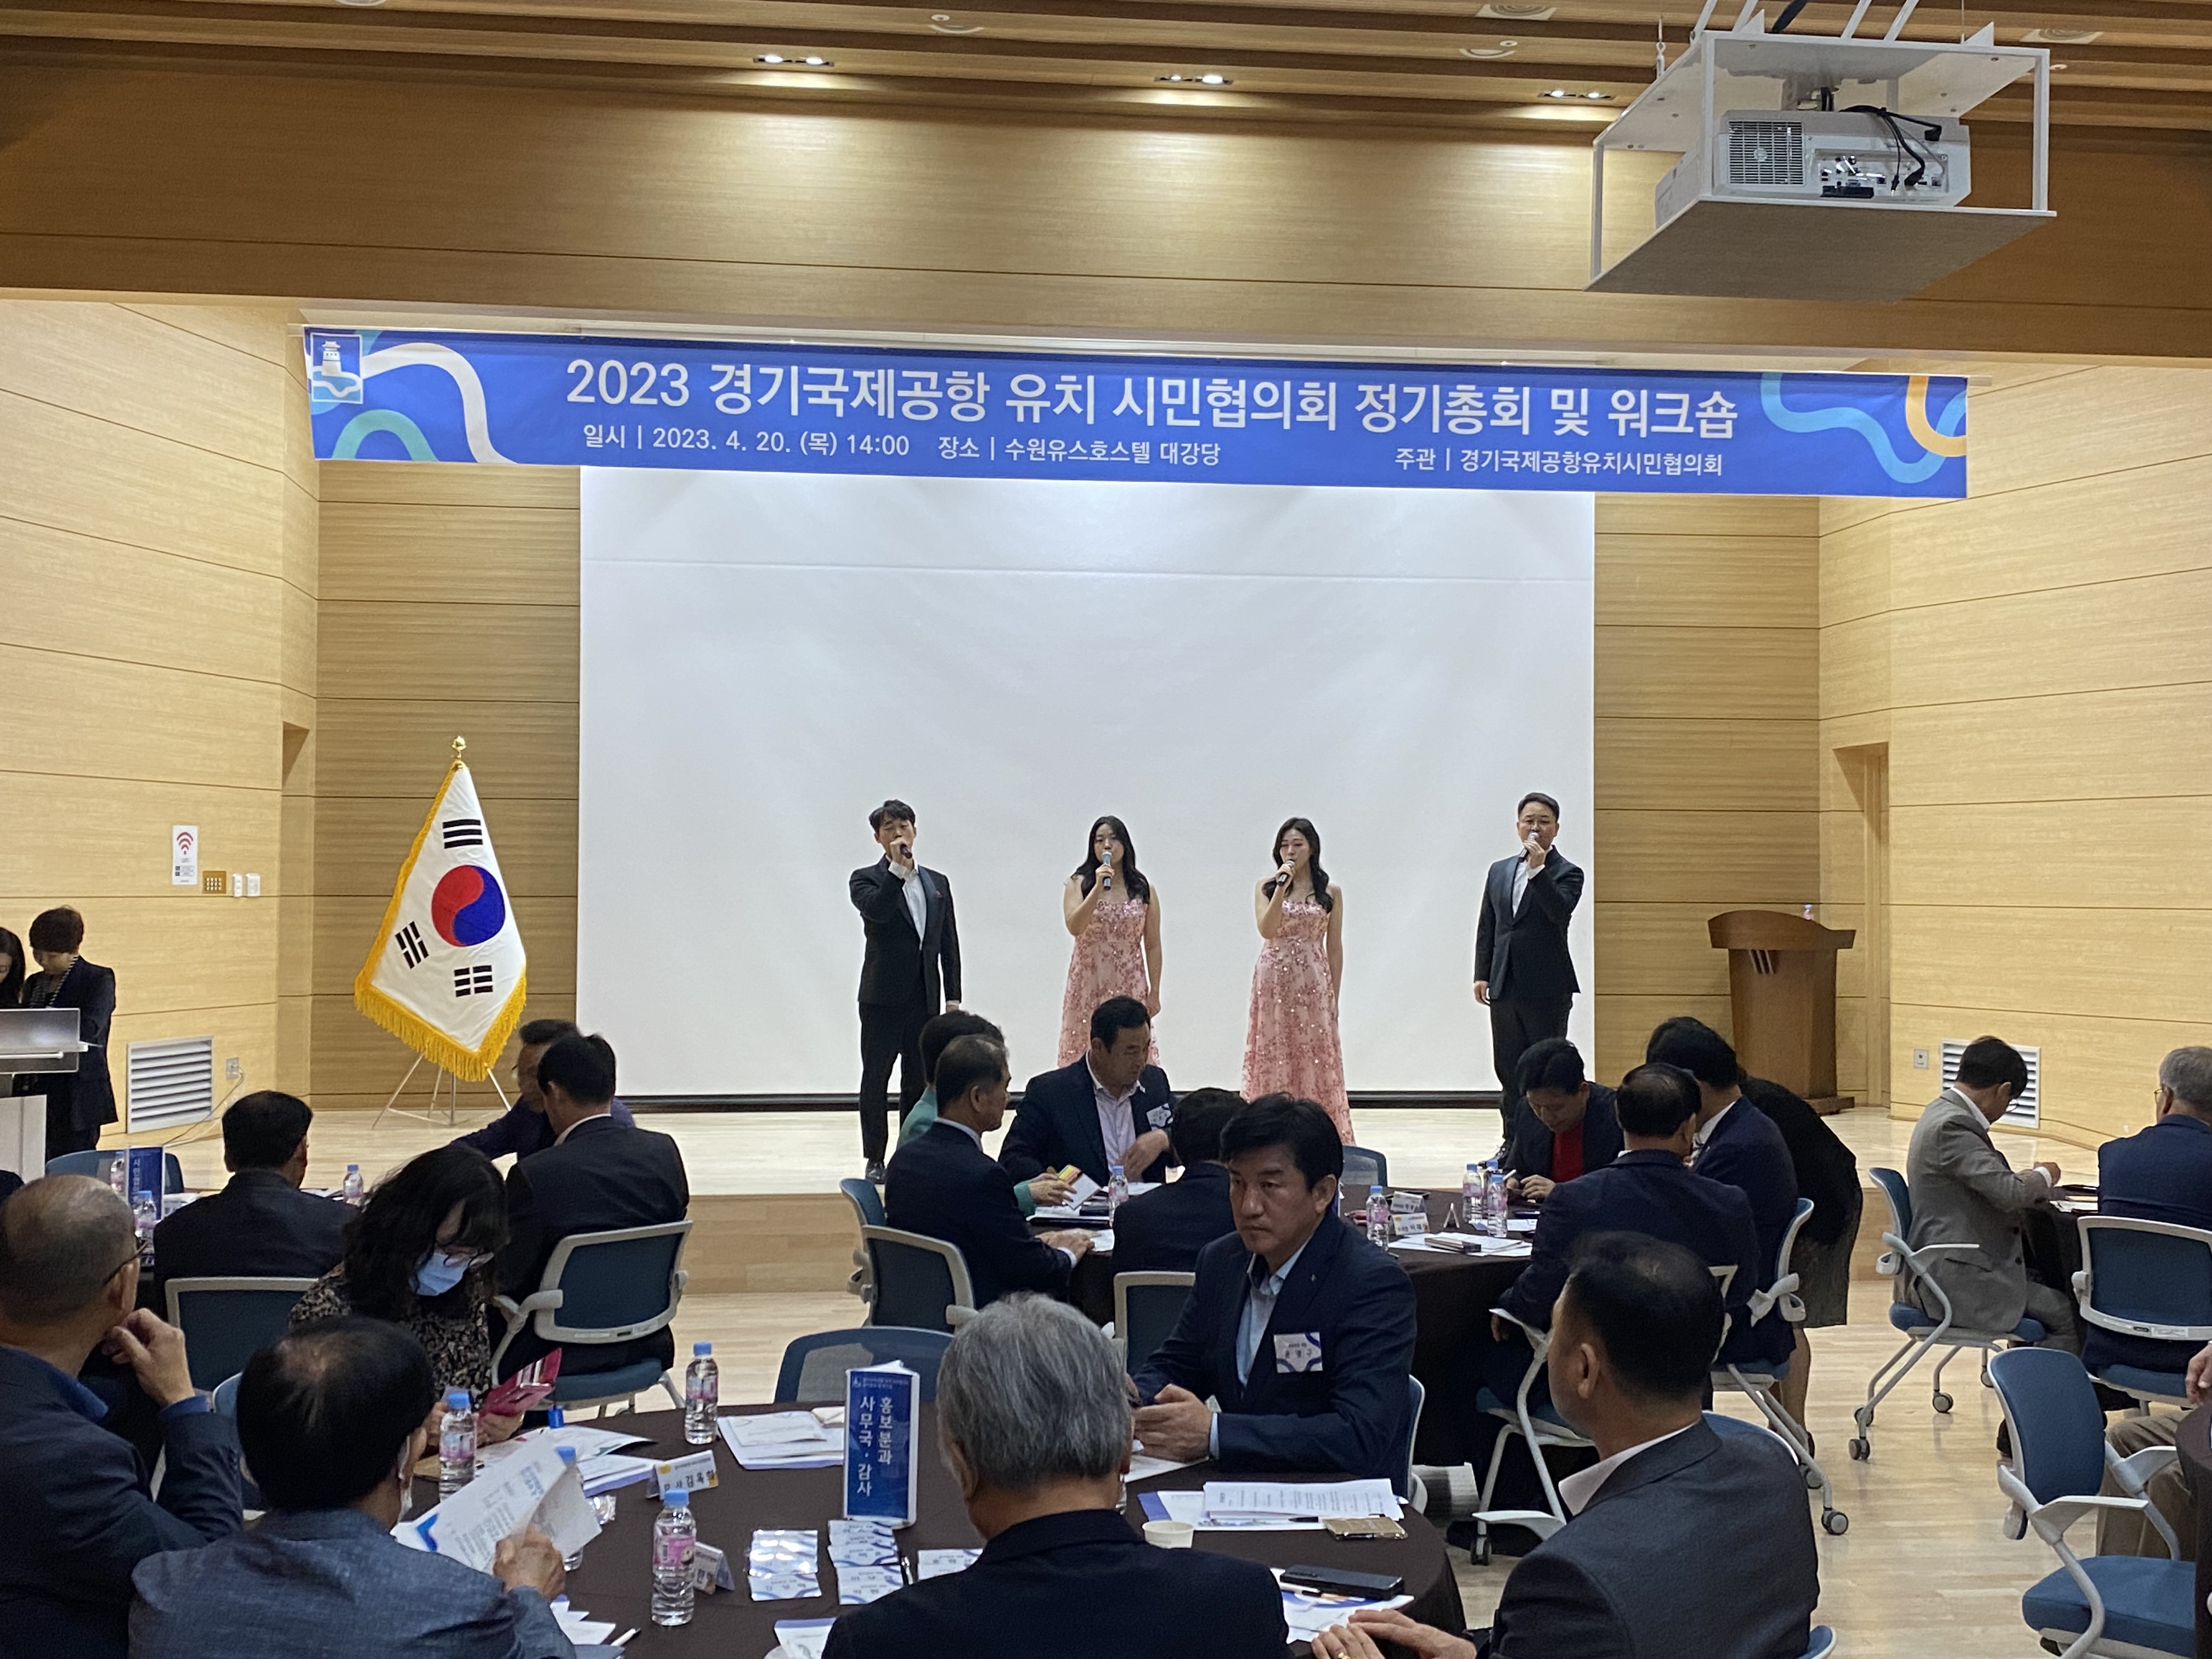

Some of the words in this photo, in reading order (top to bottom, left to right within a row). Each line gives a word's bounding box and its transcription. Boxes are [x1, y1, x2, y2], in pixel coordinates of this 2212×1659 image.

[567, 359, 690, 407] 2023
[709, 364, 991, 424] 경기국제공항
[1006, 374, 1095, 425] 유치
[1112, 377, 1336, 432] 시민협의회
[1355, 383, 1531, 436] 정기총회
[1551, 388, 1590, 437] 및
[1607, 389, 1738, 439] 워크숍
[583, 424, 625, 449] 일시
[653, 427, 716, 450] 2023.
[726, 430, 747, 451] 4.
[756, 431, 791, 453] 20.
[800, 431, 837, 458] (목)
[847, 435, 909, 455] 14:00
[938, 436, 980, 459] 장소
[1005, 438, 1150, 464] 수원유스호스텔
[1160, 442, 1221, 466] 대강당
[1395, 448, 1436, 471] 주관
[1460, 449, 1722, 477] 경기국제공항유치시민협의회
